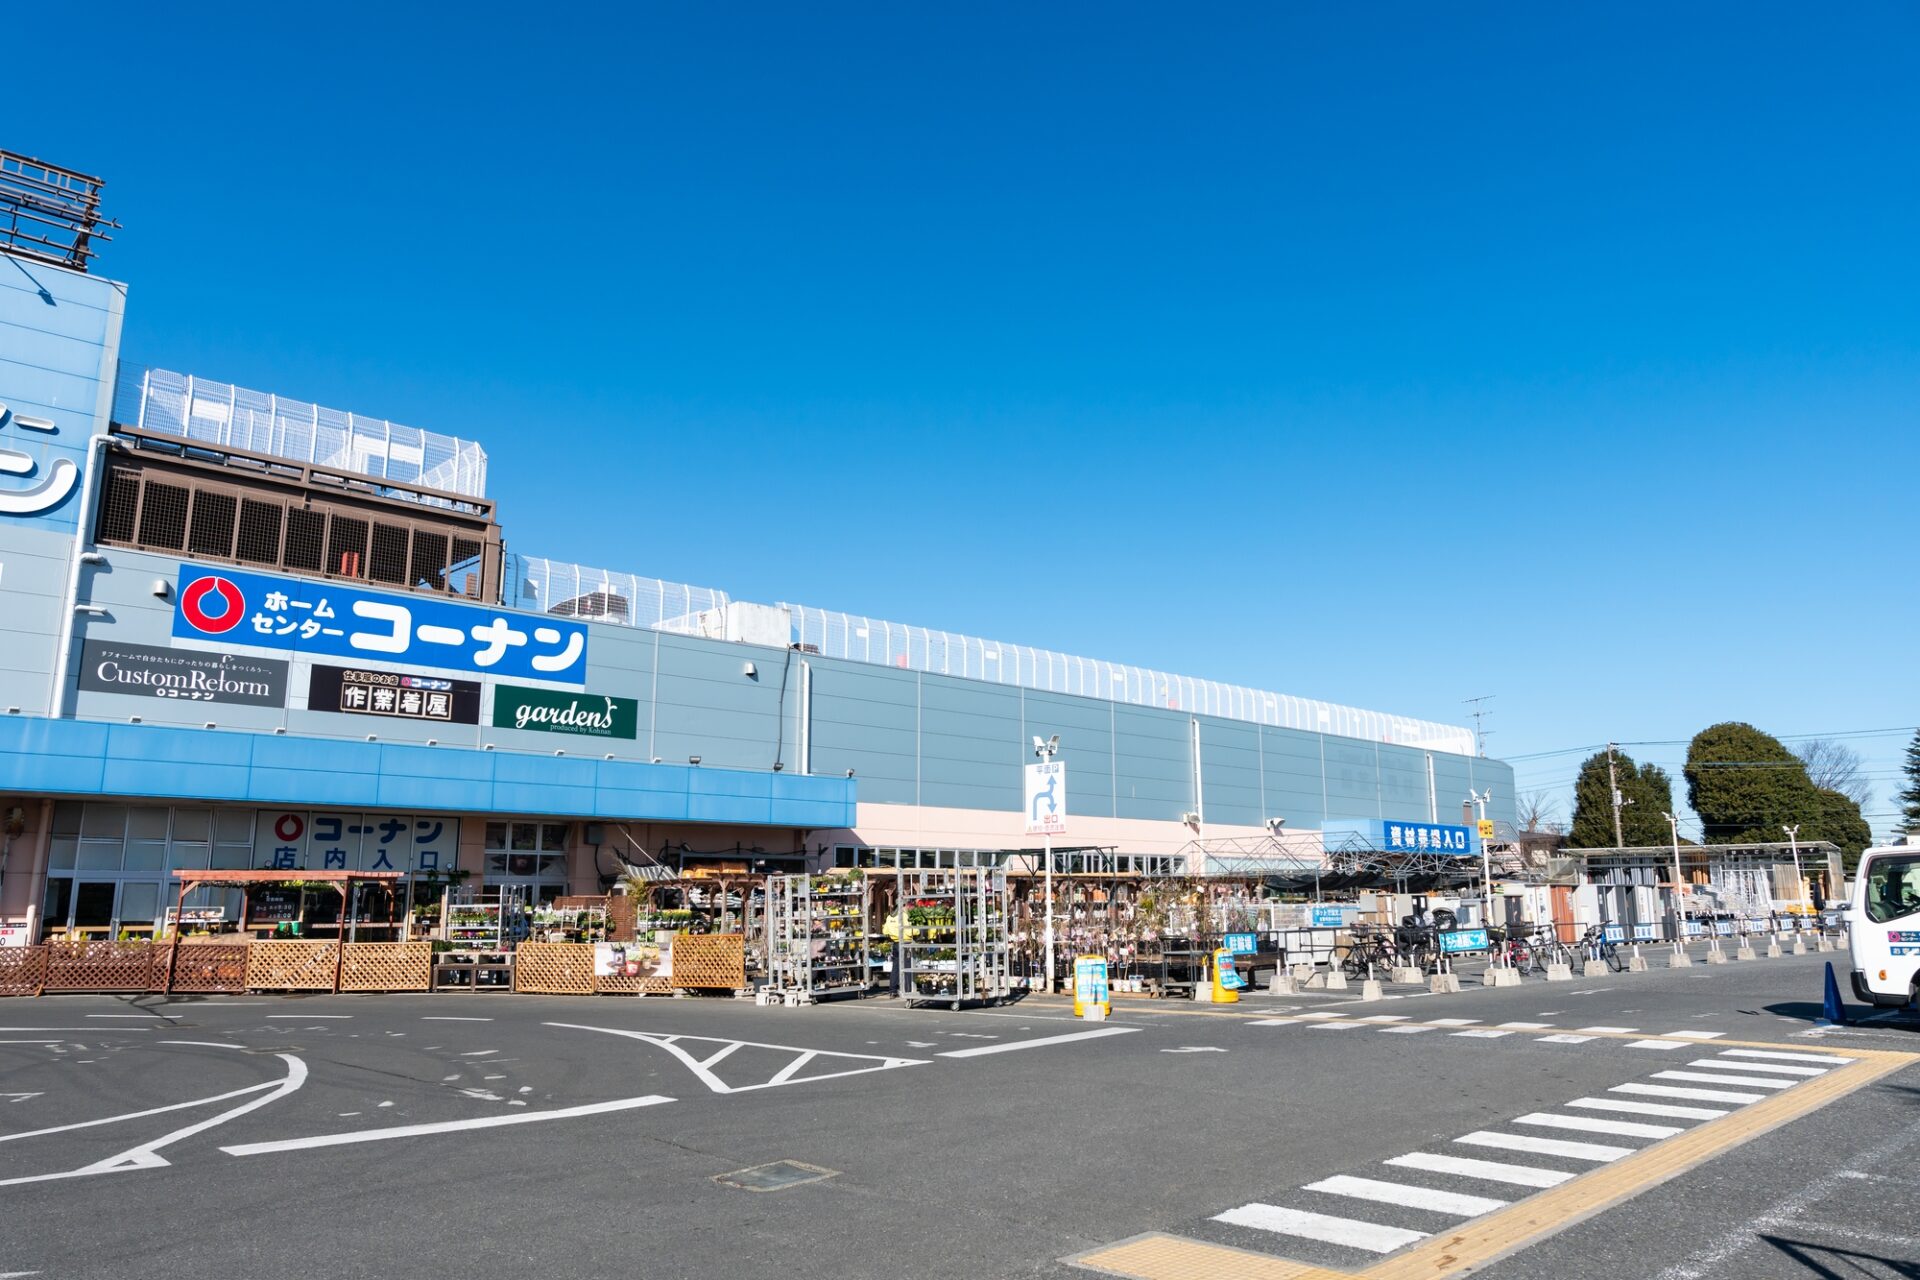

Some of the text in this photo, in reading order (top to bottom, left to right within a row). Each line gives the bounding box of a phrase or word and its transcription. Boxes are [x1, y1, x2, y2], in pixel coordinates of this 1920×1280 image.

[264, 591, 336, 618] ホーム
[251, 600, 584, 672] センター コーナン
[343, 670, 452, 690] 仕事服のお店 コーナン
[344, 686, 449, 716] 作業着屋
[550, 724, 611, 735] produced by Kohnan
[314, 817, 443, 844] コーナン
[1044, 814, 1058, 824] 出口
[1390, 825, 1465, 849] 資材売場入口
[273, 846, 438, 870] 店内入口
